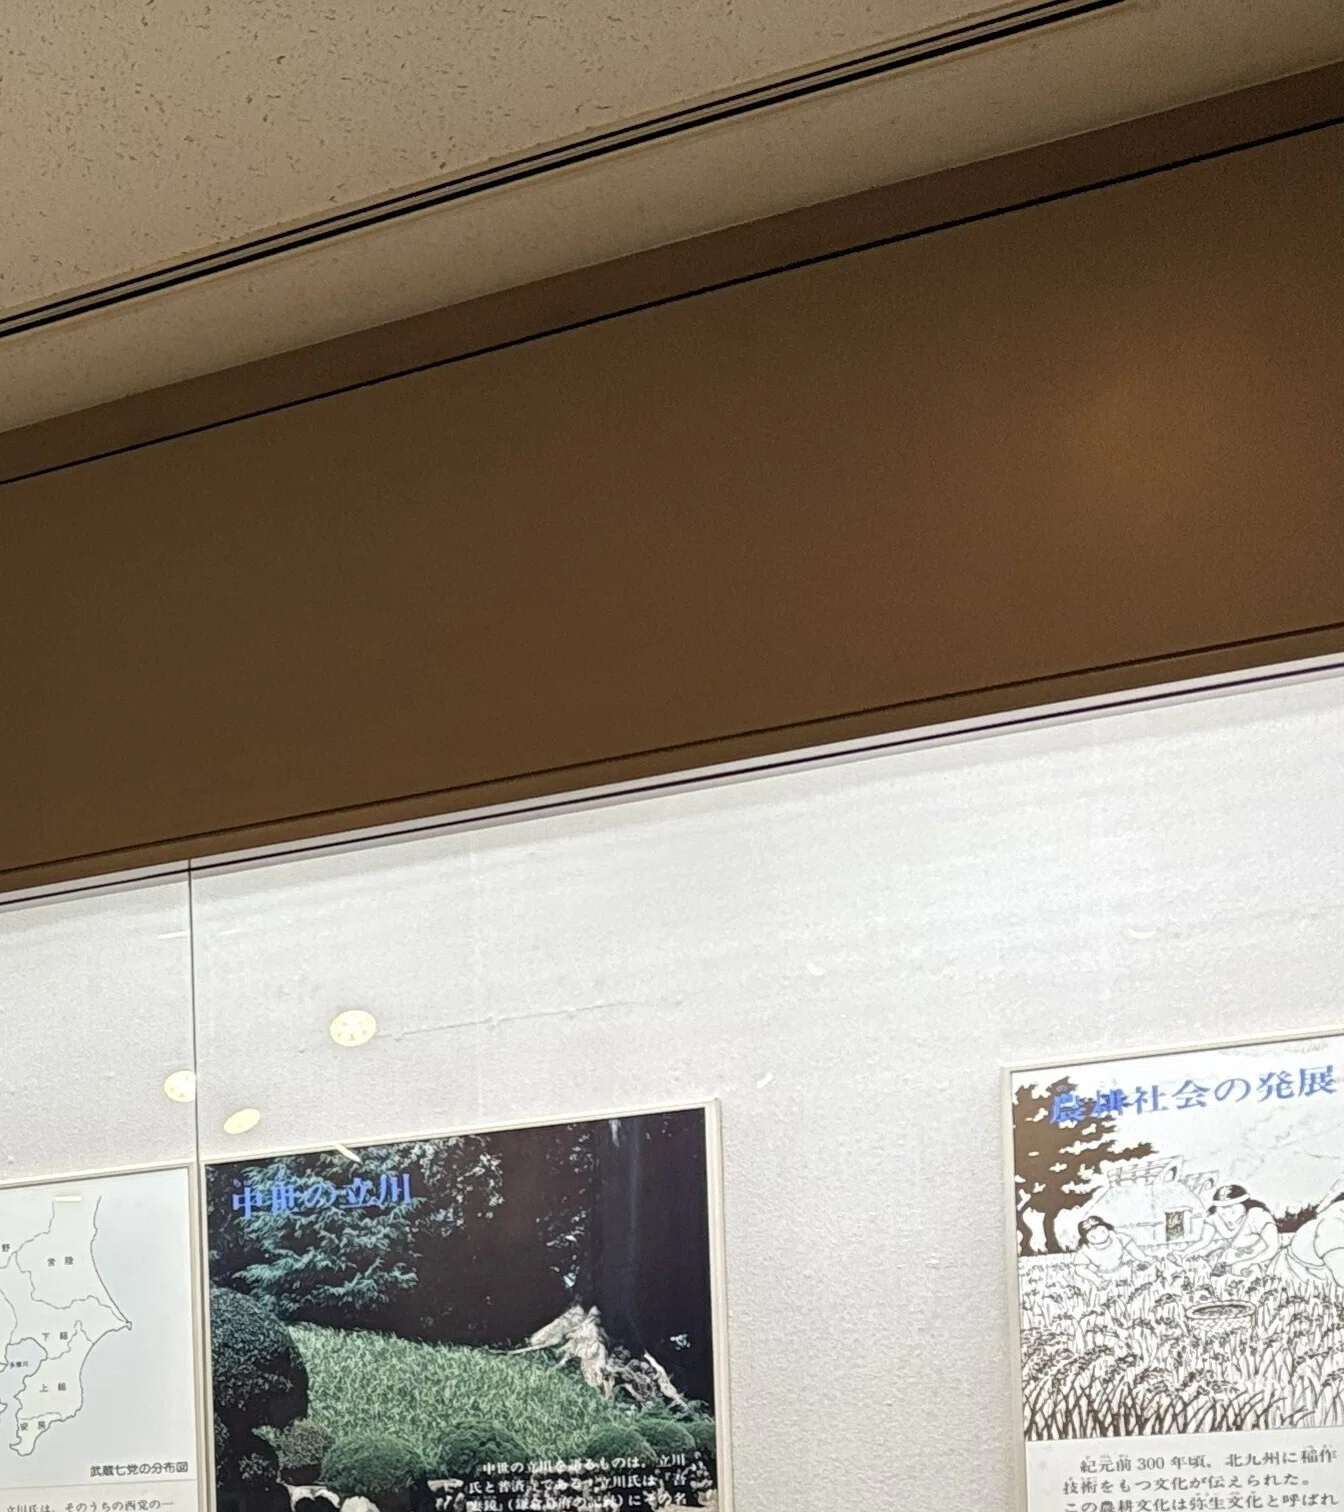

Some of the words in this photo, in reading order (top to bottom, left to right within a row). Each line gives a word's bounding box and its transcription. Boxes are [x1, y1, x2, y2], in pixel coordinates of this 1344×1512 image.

[1050, 1064, 1337, 1124] 農耕社会の発展
[232, 1173, 412, 1219] 中世の立川
